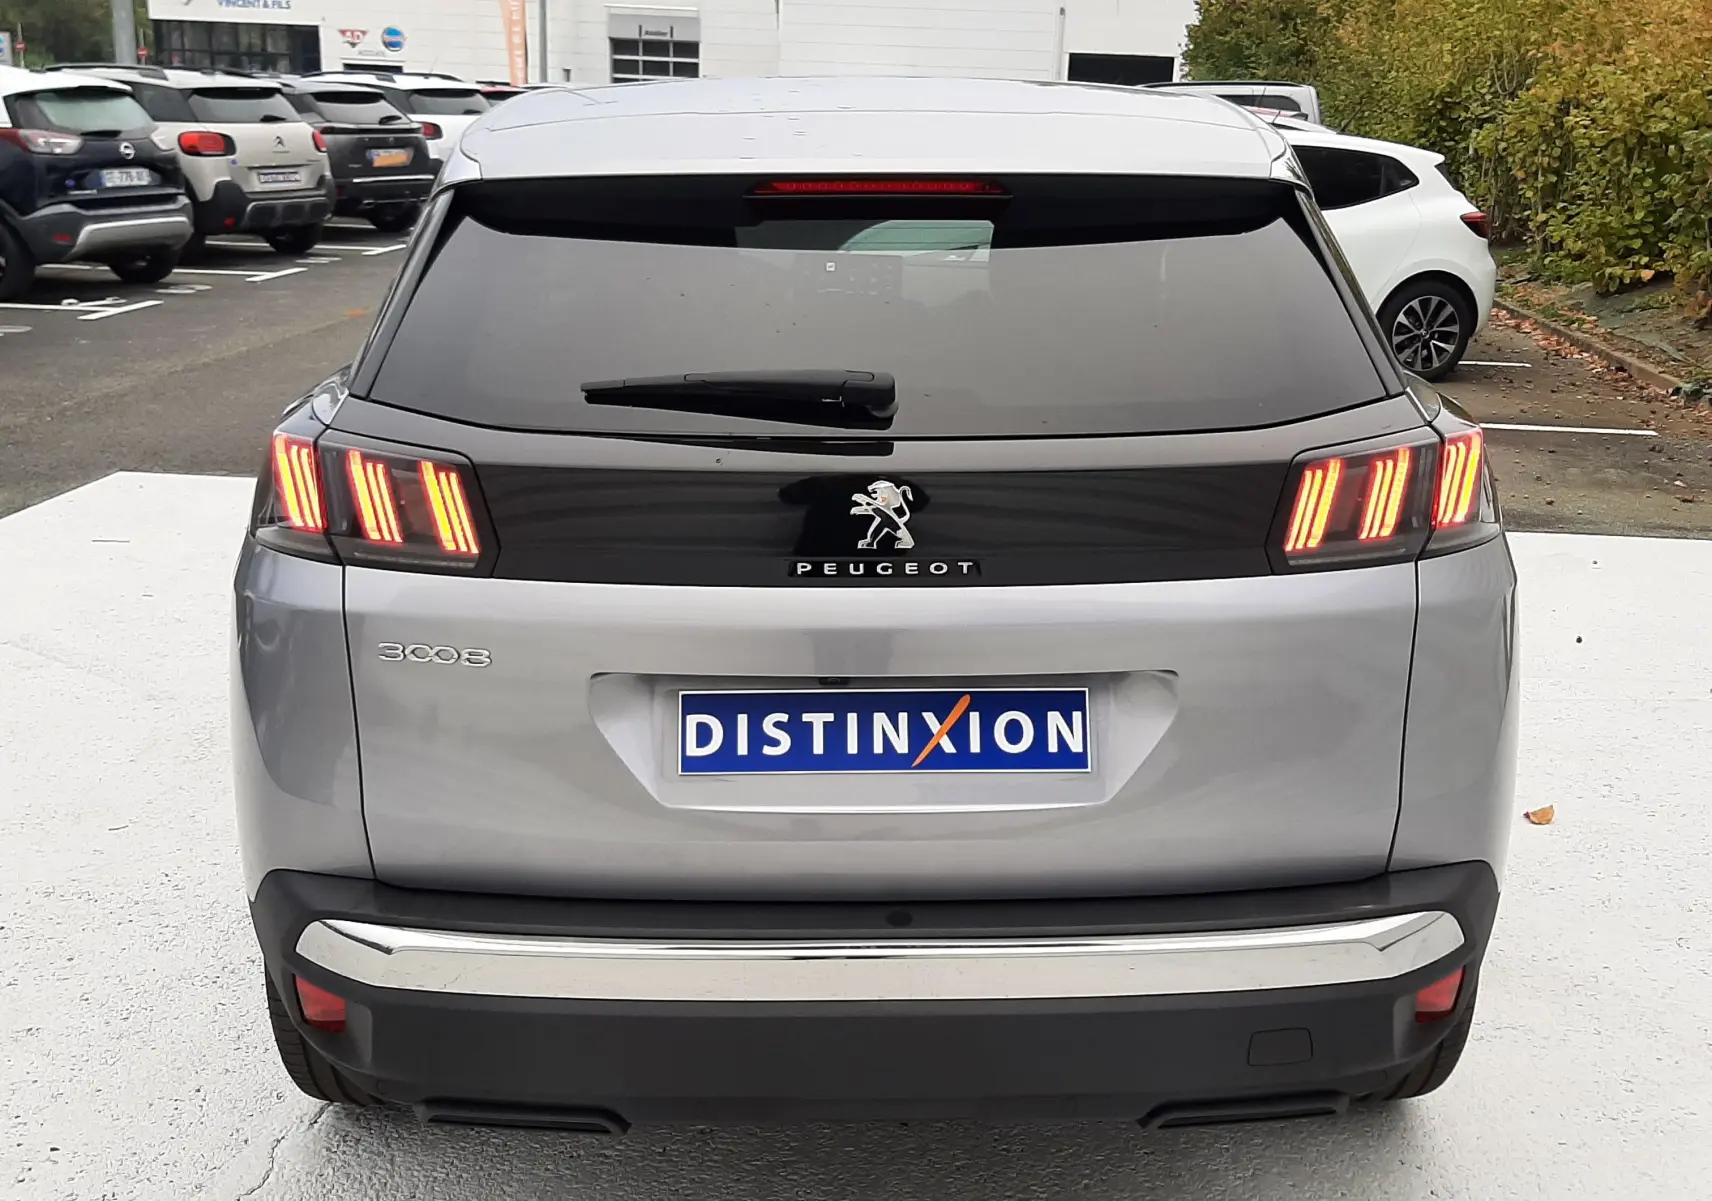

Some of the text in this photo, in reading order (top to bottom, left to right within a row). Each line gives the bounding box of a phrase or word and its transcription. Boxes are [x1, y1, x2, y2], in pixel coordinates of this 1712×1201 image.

[272, 0, 292, 9] FILS
[796, 561, 974, 575] PEUGEOT
[377, 641, 492, 668] 3008
[685, 696, 1084, 767] DISTINXION
